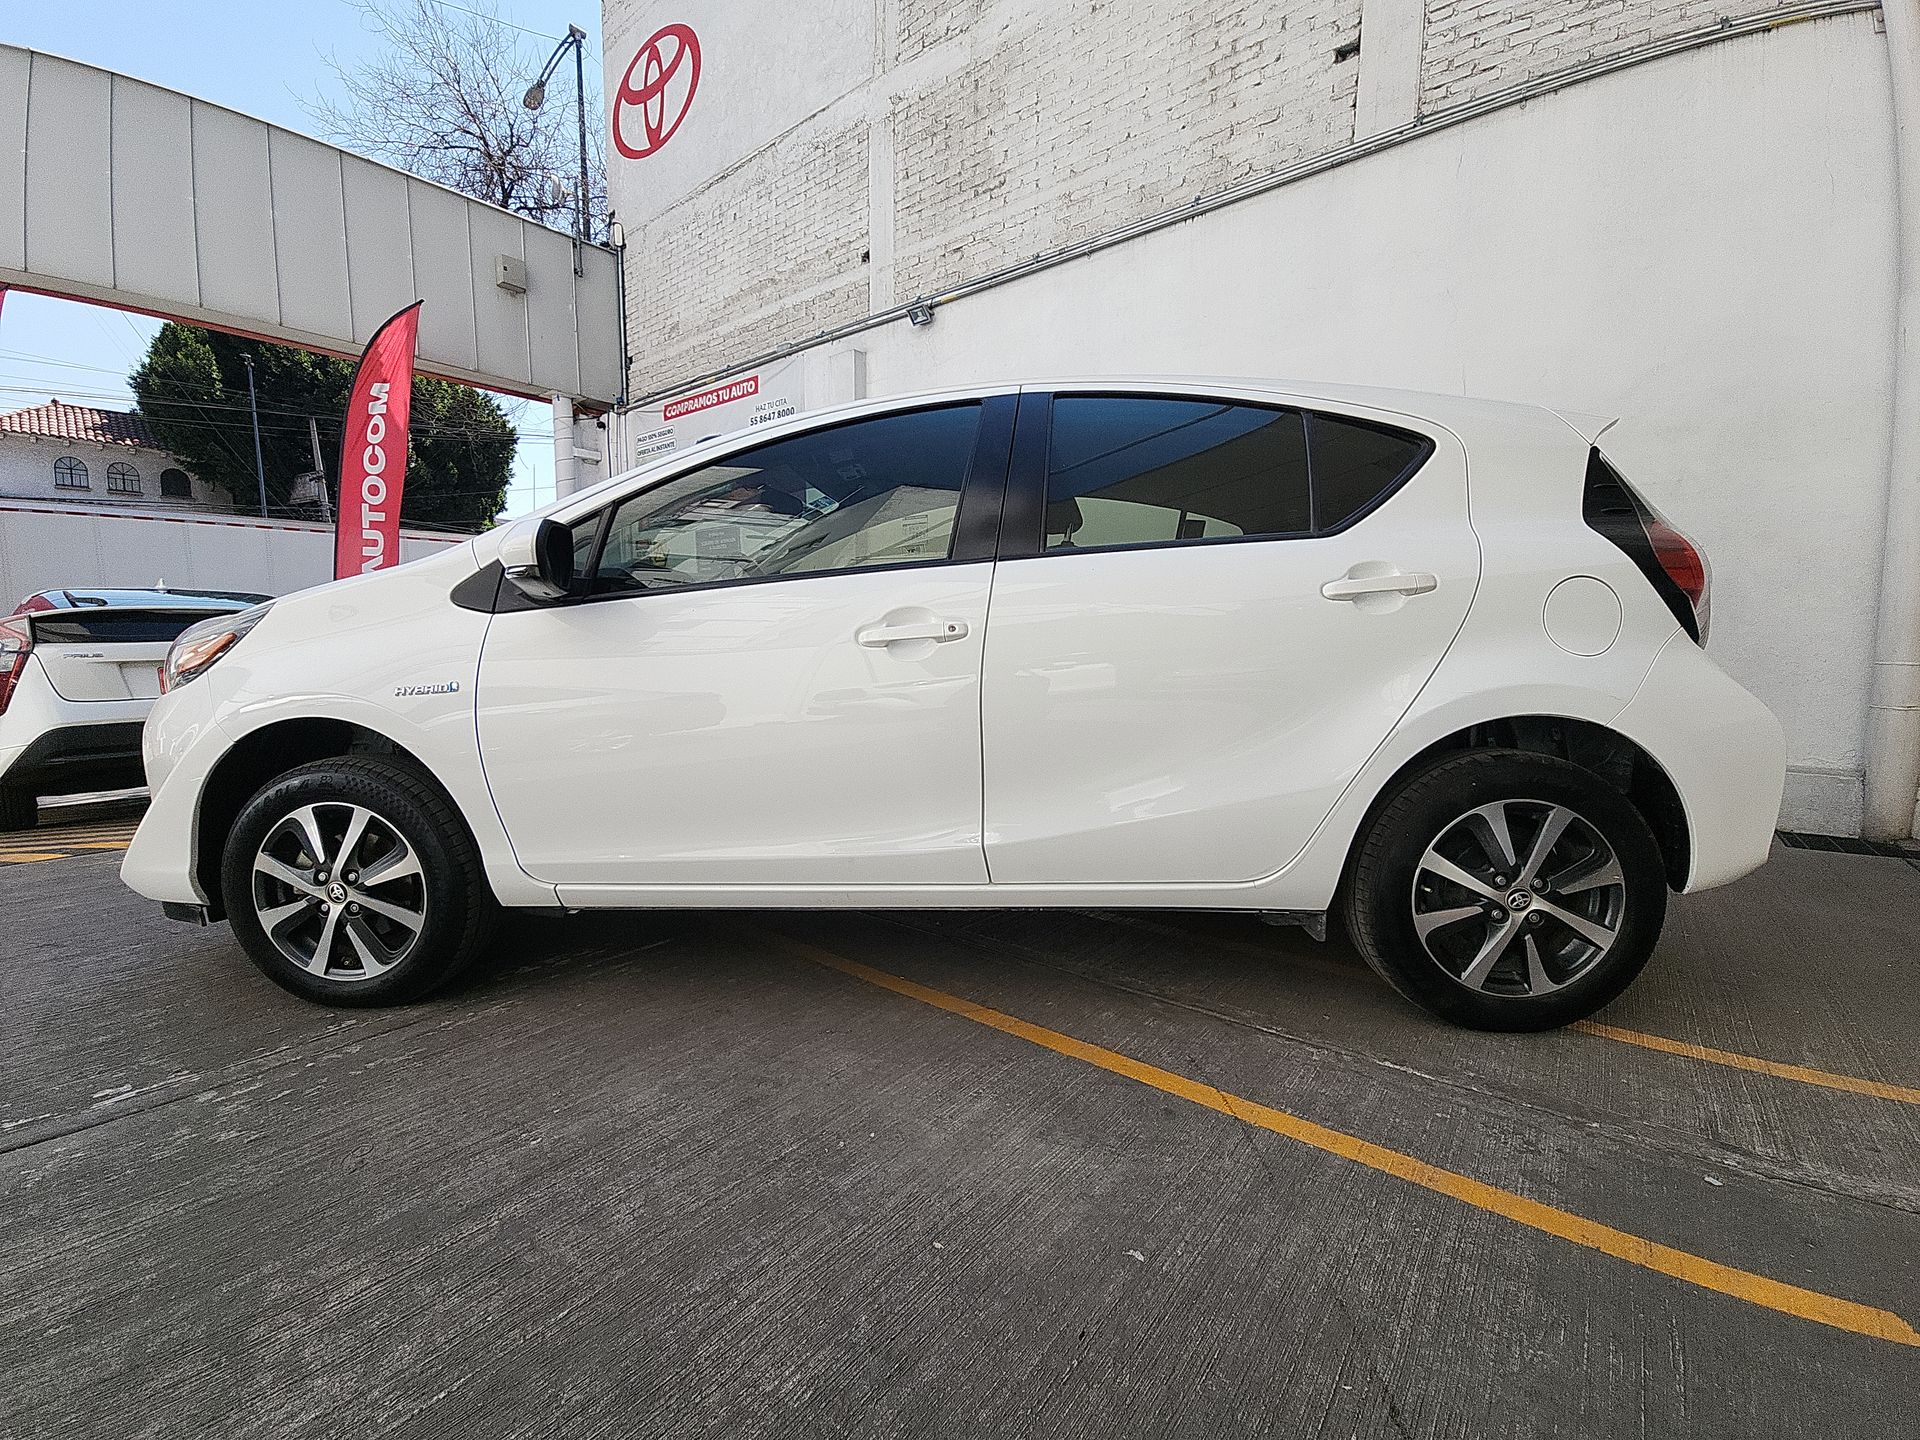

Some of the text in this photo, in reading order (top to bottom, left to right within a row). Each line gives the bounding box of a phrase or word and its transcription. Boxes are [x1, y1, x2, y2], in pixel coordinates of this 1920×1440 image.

[665, 381, 756, 417] COMPRAMOS TU AUTO
[755, 397, 788, 412] HAZ TU CITA
[750, 406, 795, 426] 55 8647 8000
[657, 428, 673, 438] SEGURO
[636, 447, 651, 457] OFERTA
[656, 441, 675, 452] INSTANTE
[361, 382, 390, 574] AUTOCOM
[394, 684, 449, 697] HYBRID
